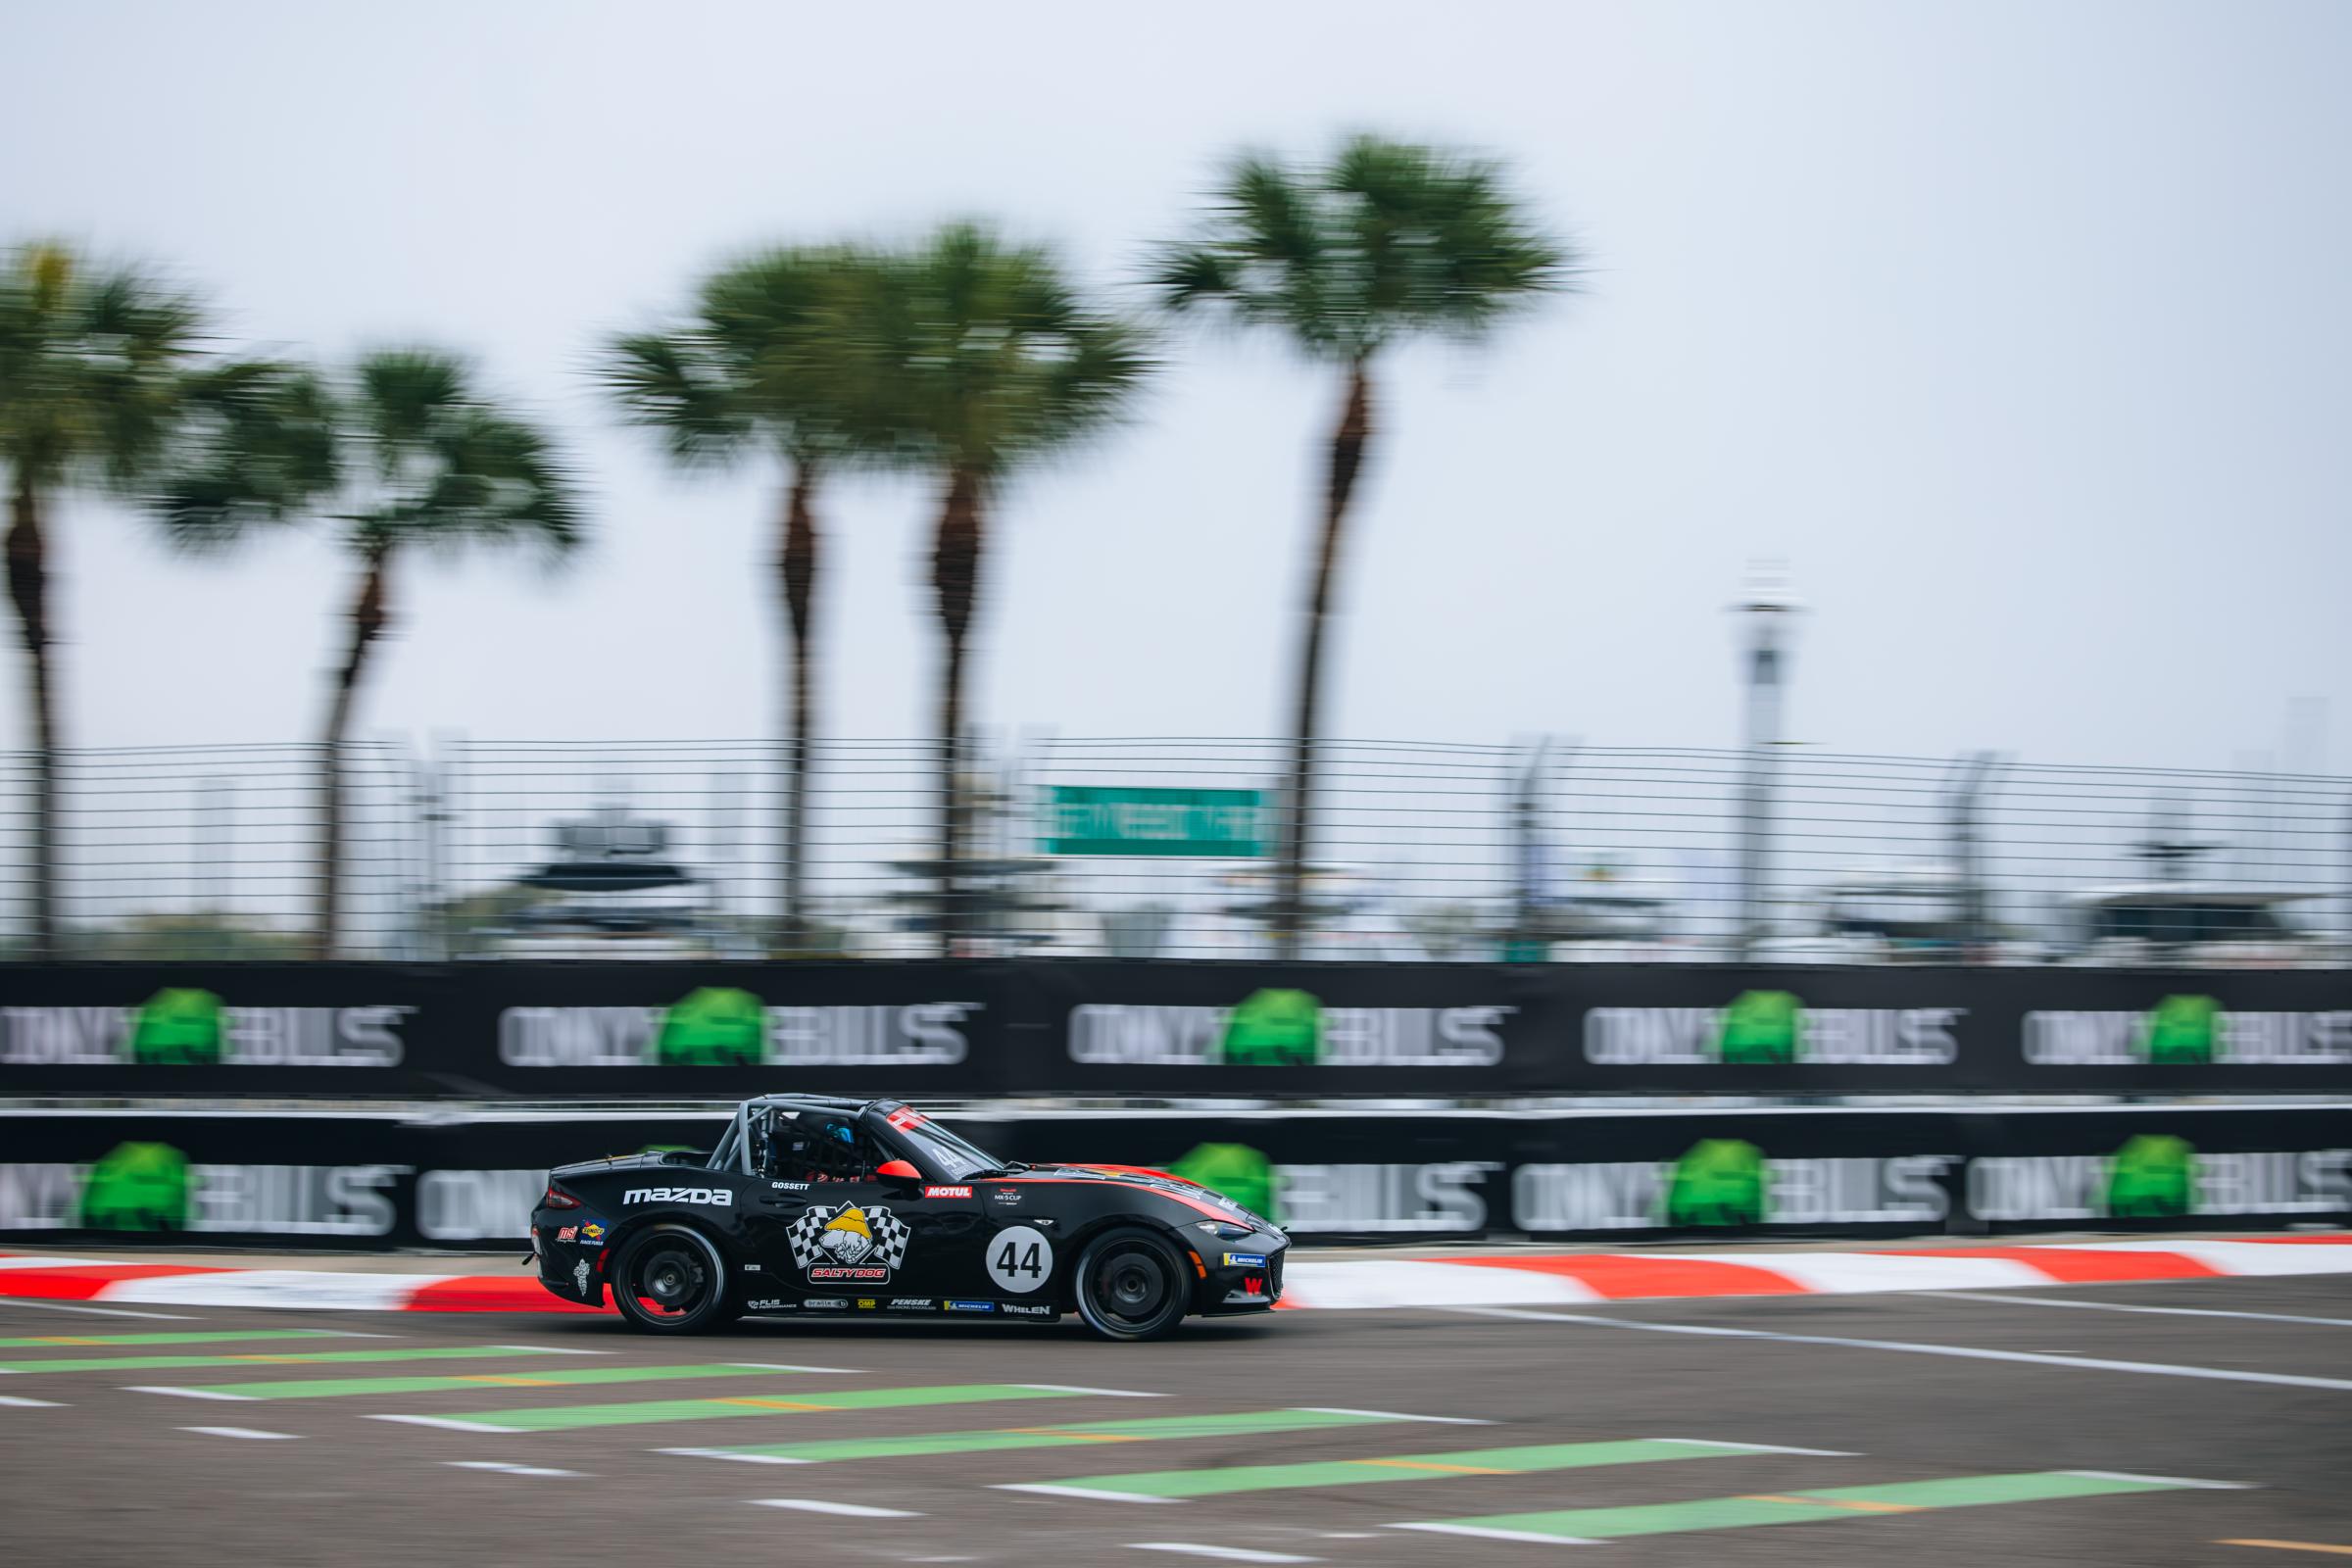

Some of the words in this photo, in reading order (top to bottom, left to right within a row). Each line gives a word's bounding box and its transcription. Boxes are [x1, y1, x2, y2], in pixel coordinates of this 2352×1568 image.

[771, 1181, 810, 1191] GOSSETT
[927, 1187, 970, 1197] MOTUL
[997, 1242, 1042, 1278] 44
[1002, 1303, 1051, 1314] WHELEN
